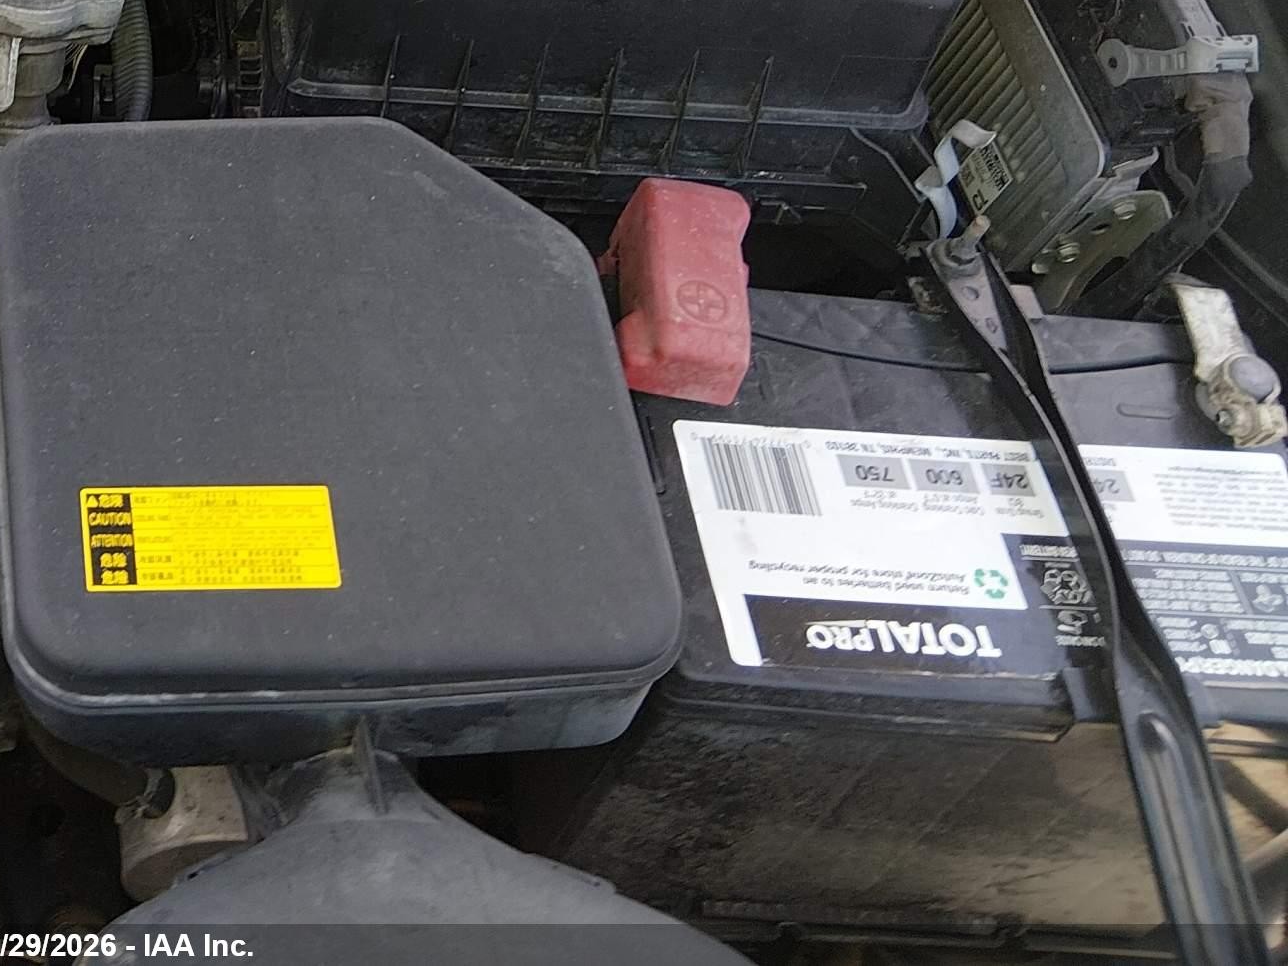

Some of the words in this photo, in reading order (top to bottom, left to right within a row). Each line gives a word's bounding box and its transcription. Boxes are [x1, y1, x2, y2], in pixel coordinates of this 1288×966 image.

[854, 465, 895, 483] 750
[925, 468, 963, 486] 600
[990, 472, 1028, 490] 24F
[88, 512, 132, 526] CAUTION
[91, 534, 133, 548] ATTENTION
[748, 561, 806, 573] recycling
[808, 564, 849, 576] proper
[851, 568, 870, 579] for
[872, 569, 903, 580] store
[837, 578, 892, 592] batteries
[895, 582, 926, 594] used
[927, 584, 970, 595] Return
[806, 620, 1003, 658] TOTALPRO
